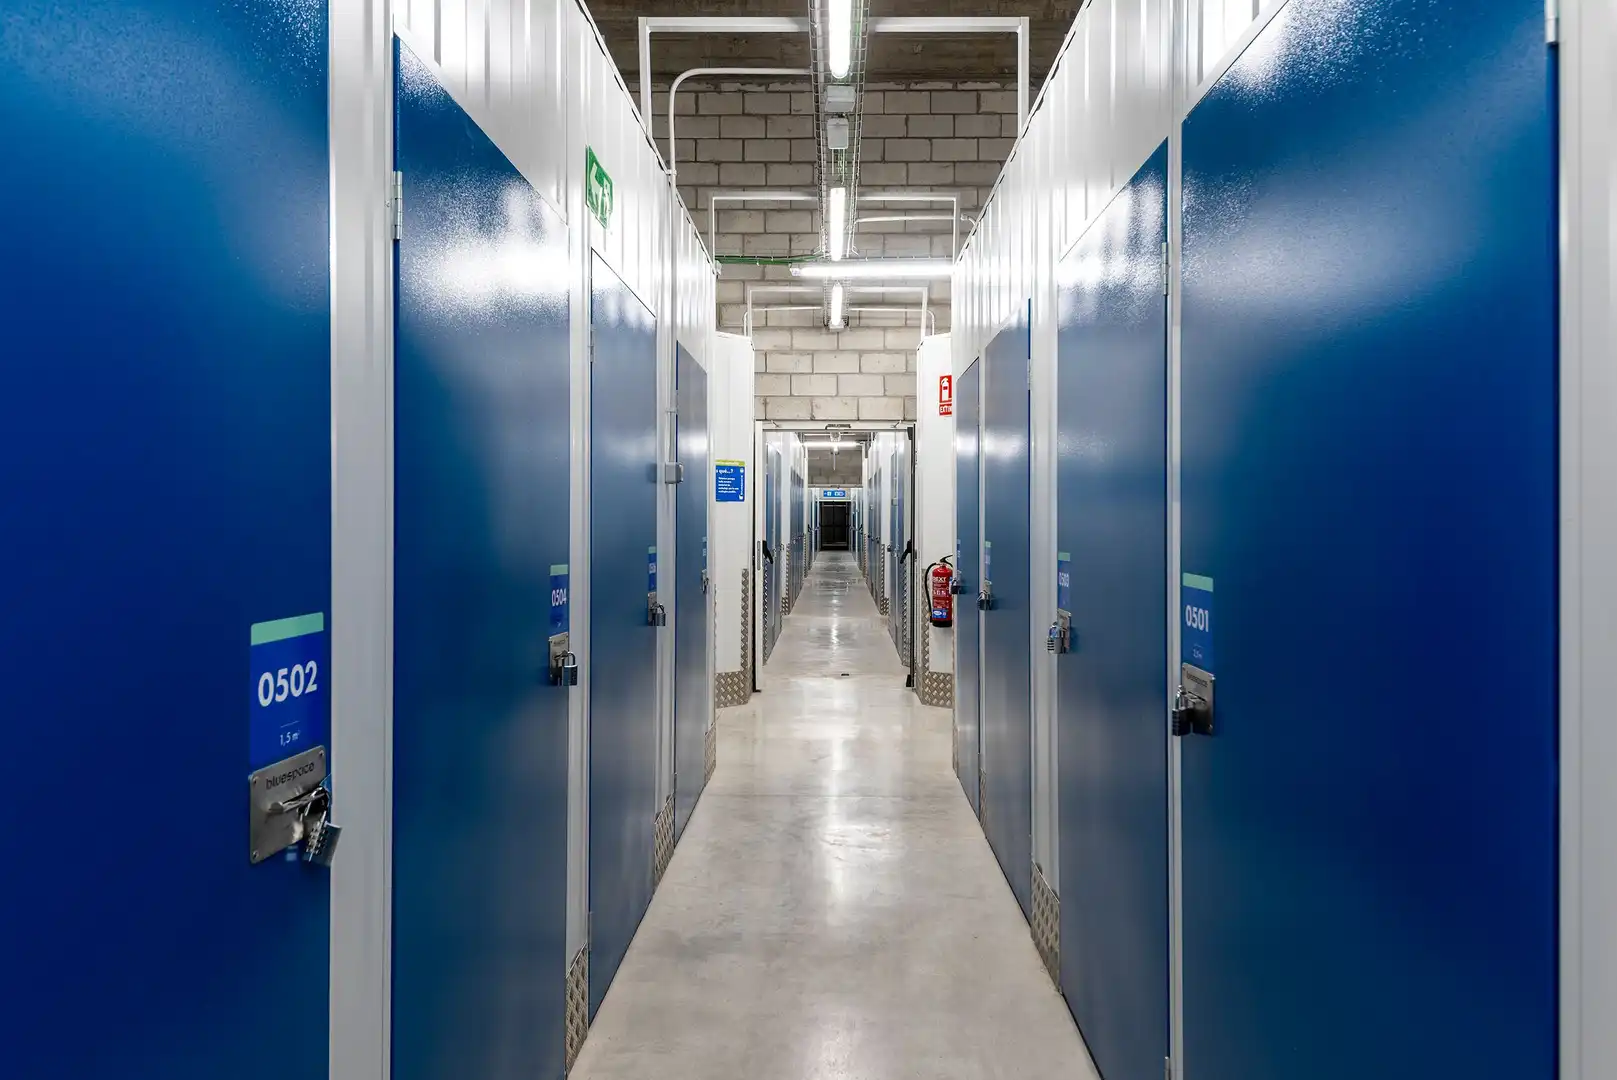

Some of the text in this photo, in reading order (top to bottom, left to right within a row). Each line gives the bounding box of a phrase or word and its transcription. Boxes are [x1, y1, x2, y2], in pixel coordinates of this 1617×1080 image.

[551, 588, 567, 607] 0504
[1185, 604, 1209, 632] 0501
[257, 660, 318, 707] 0502
[280, 732, 291, 746] 1,5
[265, 761, 315, 790] bluespace
